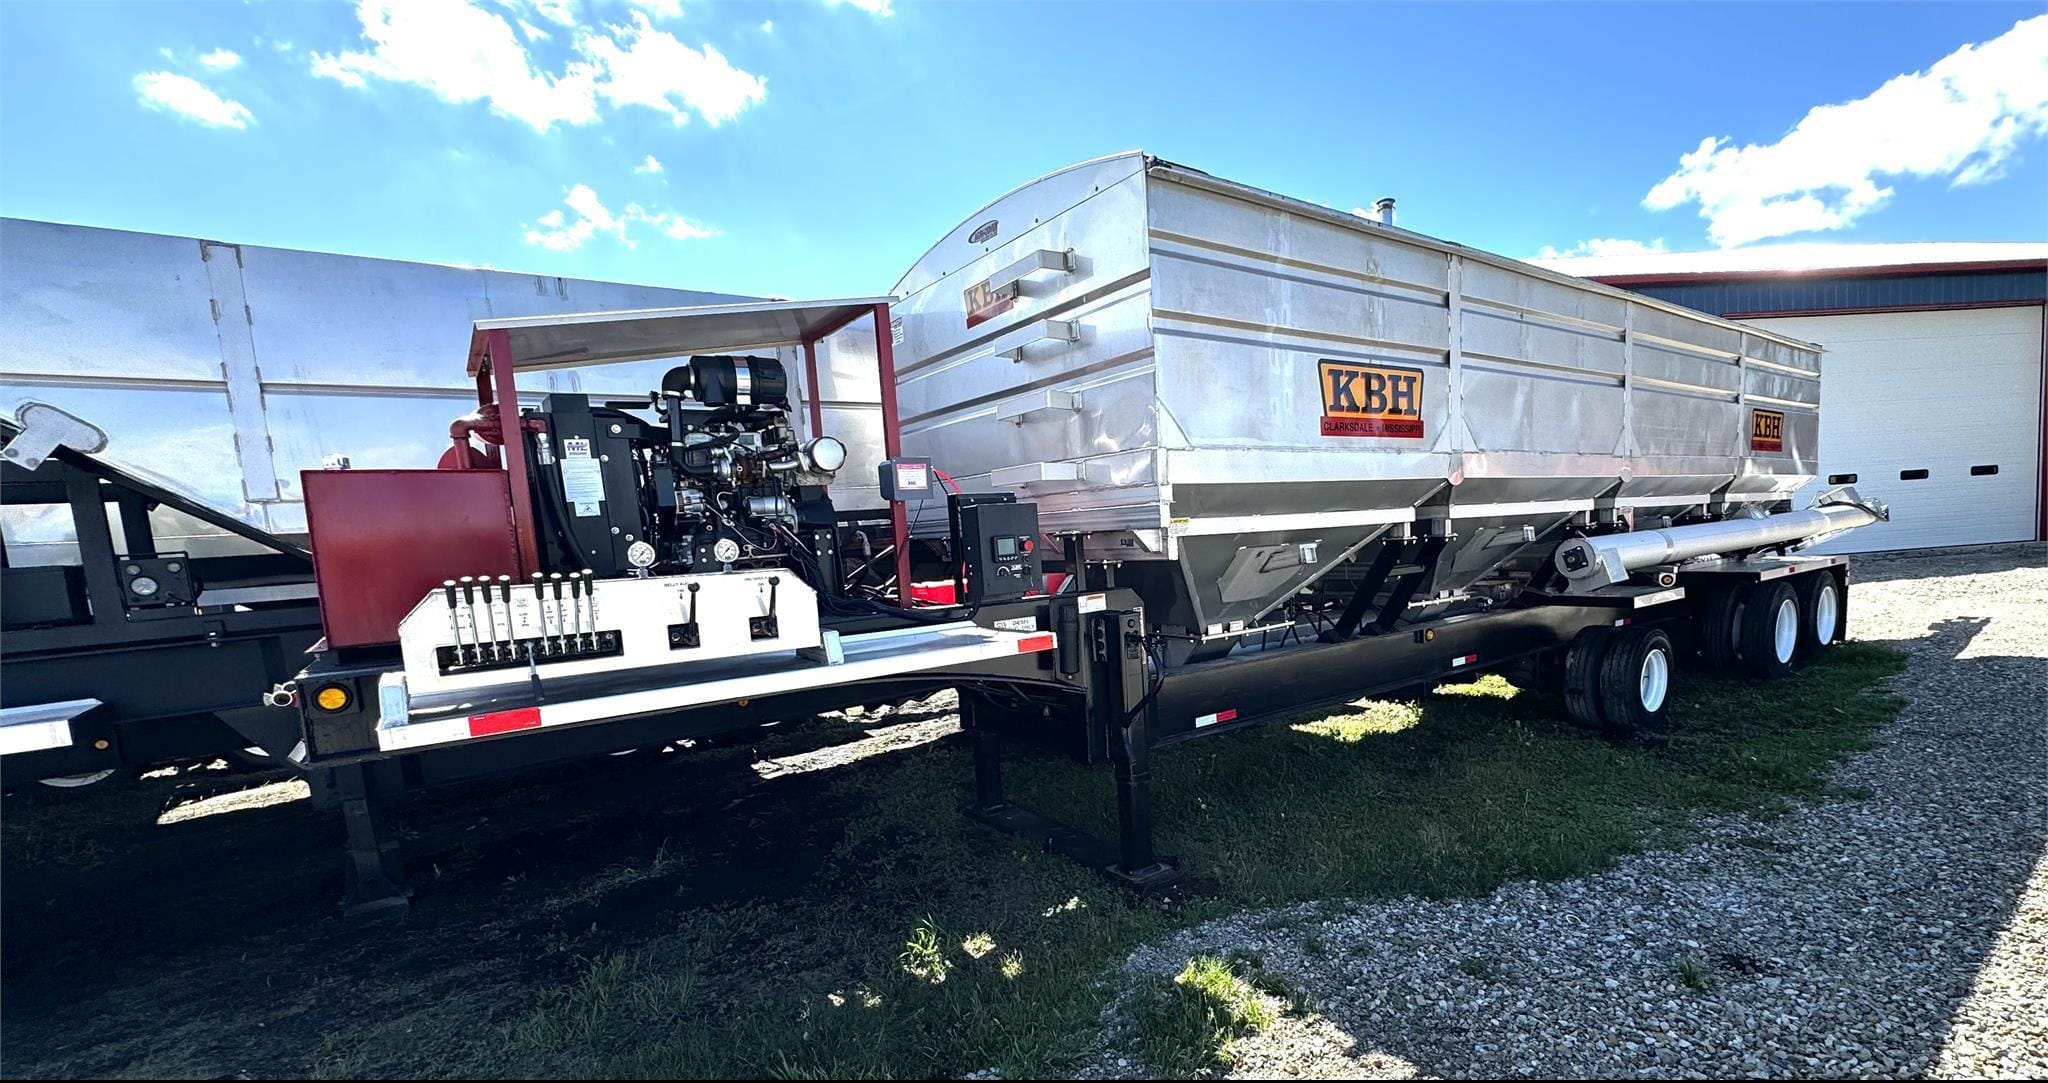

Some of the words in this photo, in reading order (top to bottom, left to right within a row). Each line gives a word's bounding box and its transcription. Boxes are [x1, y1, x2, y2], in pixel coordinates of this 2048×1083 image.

[1327, 369, 1418, 415] KBH
[1323, 421, 1373, 432] CLARKSDALE
[1754, 413, 1781, 438] KBH
